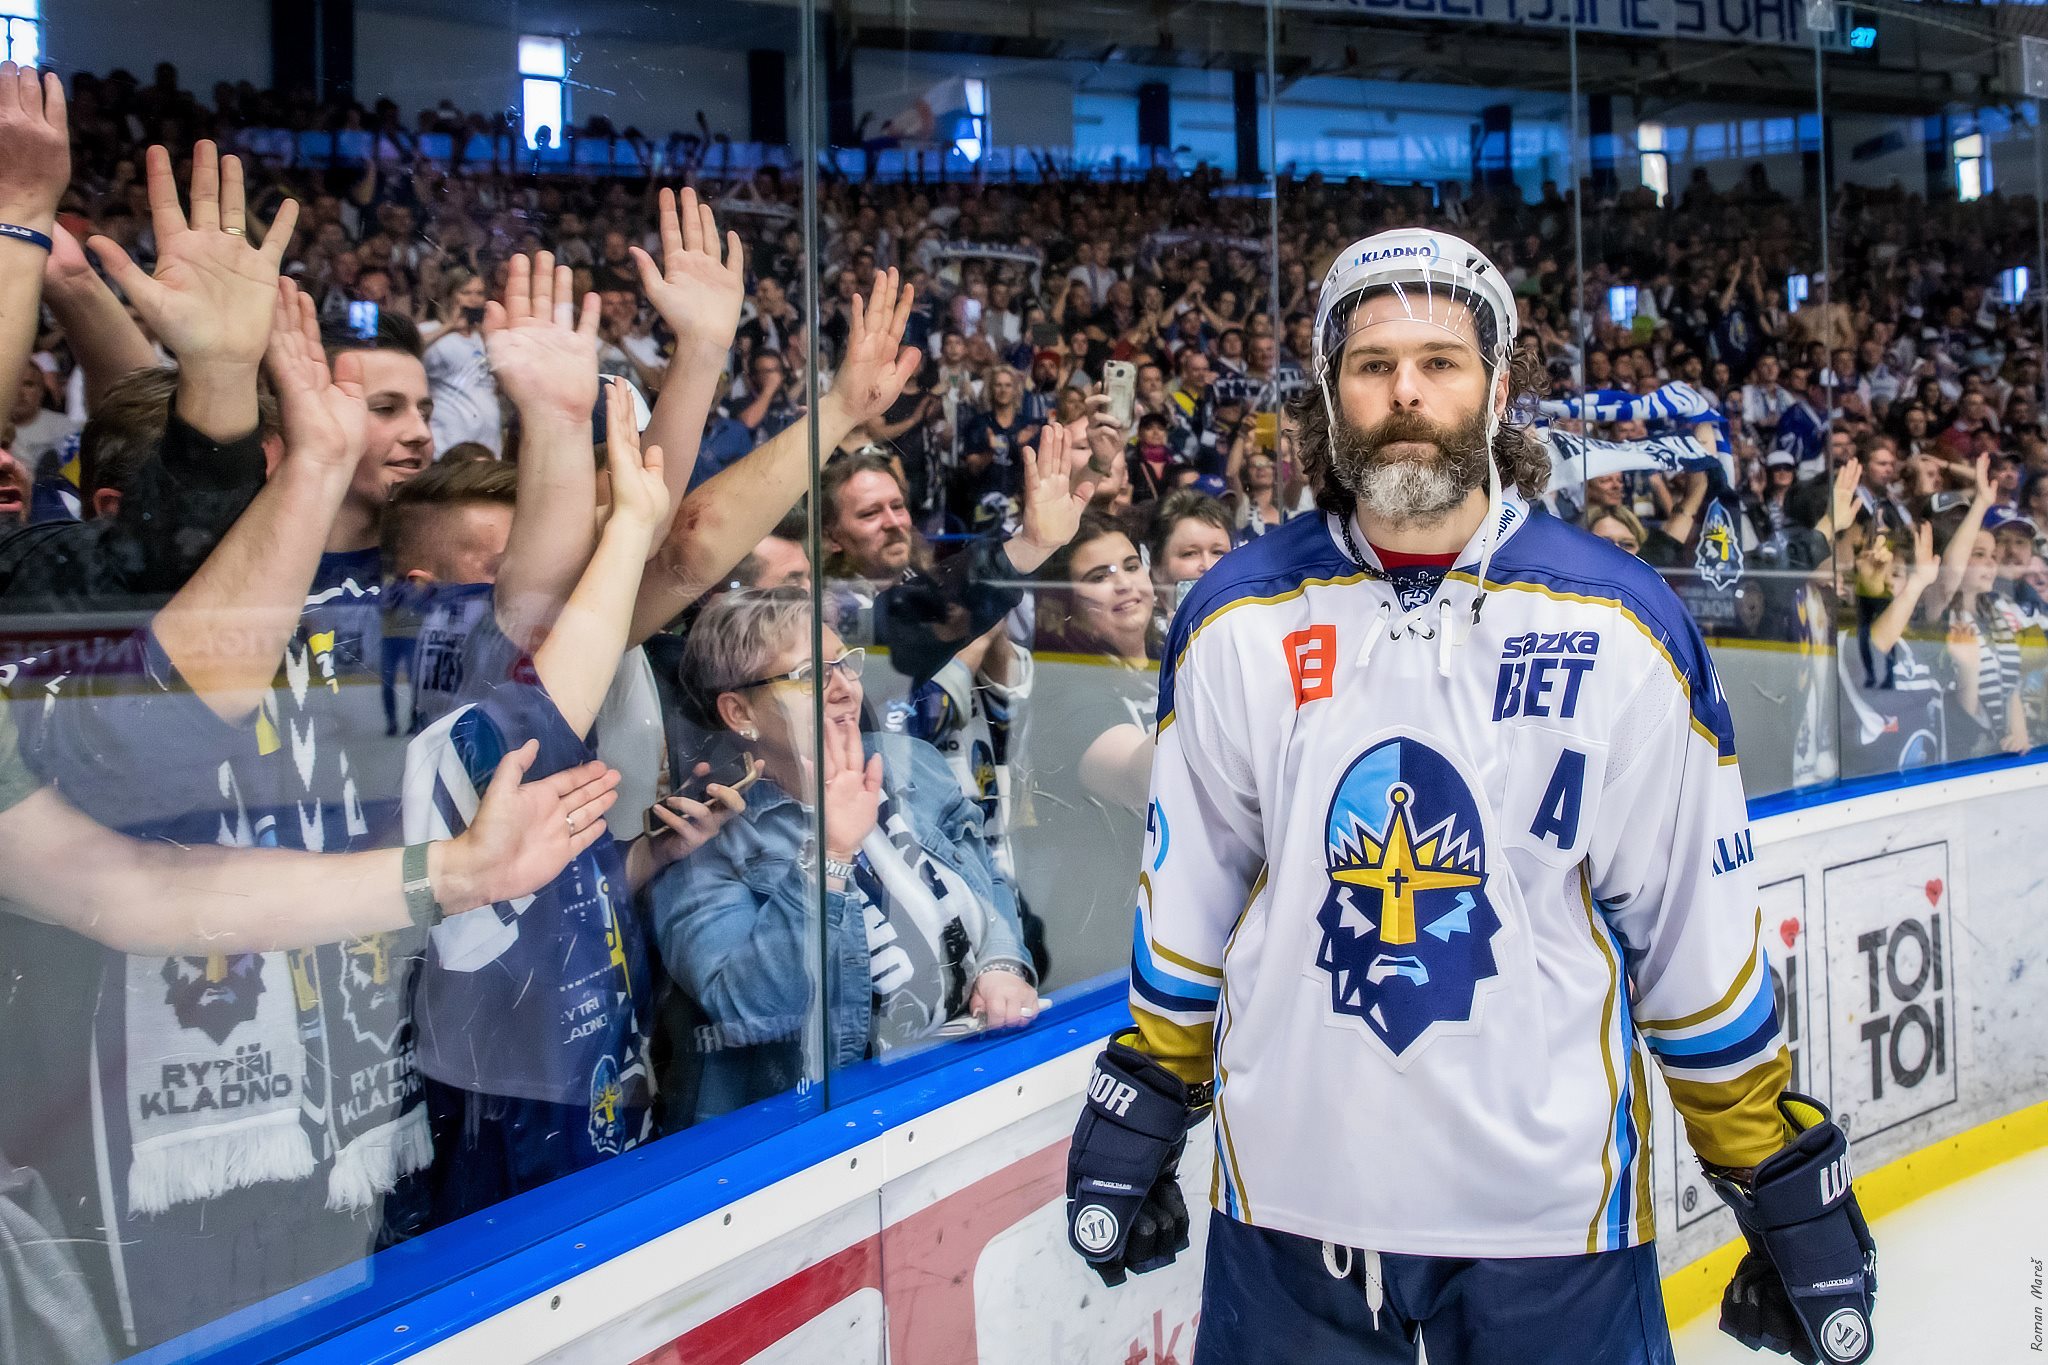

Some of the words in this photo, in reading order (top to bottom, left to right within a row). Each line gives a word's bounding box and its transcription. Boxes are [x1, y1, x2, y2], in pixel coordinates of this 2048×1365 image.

[1361, 246, 1431, 265] KLADNO
[1491, 658, 1595, 722] BET
[1528, 747, 1587, 850] A
[1858, 912, 1943, 1013] TOI
[1860, 996, 1946, 1101] TOI
[139, 1073, 293, 1120] KLADNO
